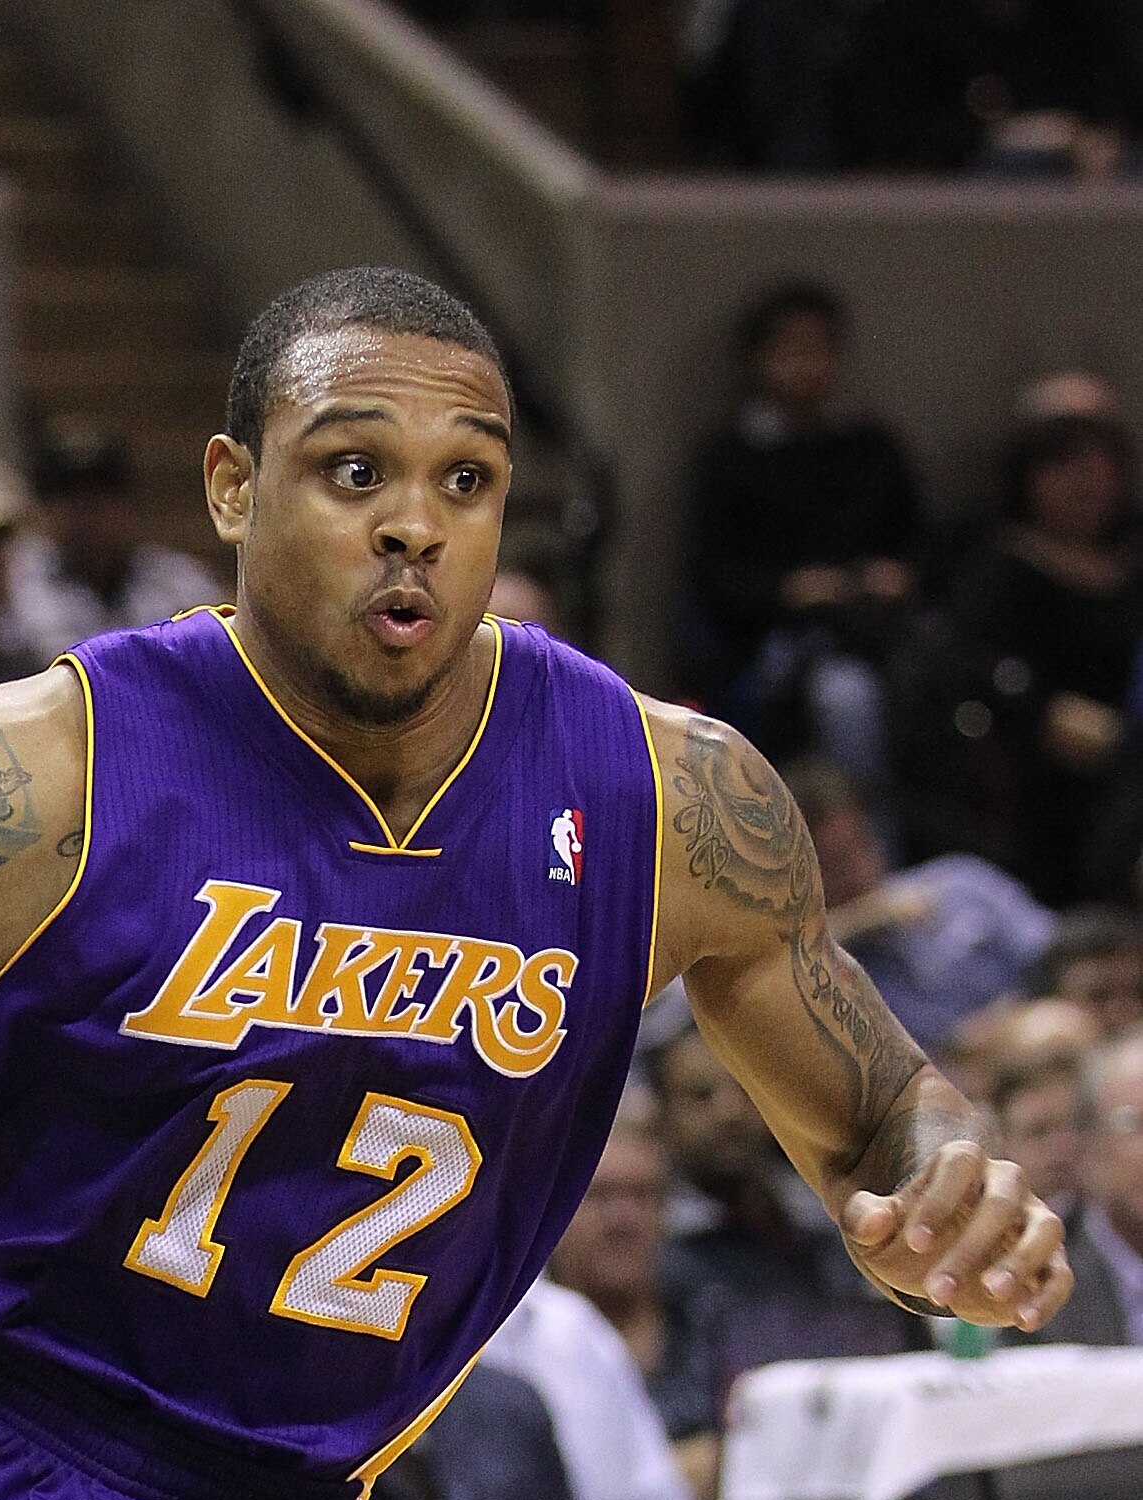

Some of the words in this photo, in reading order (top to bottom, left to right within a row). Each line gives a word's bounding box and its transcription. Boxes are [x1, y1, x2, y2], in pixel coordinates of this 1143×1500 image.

[548, 867, 571, 882] NBA
[118, 879, 579, 1078] LAKERS
[122, 1079, 483, 1342] 12
